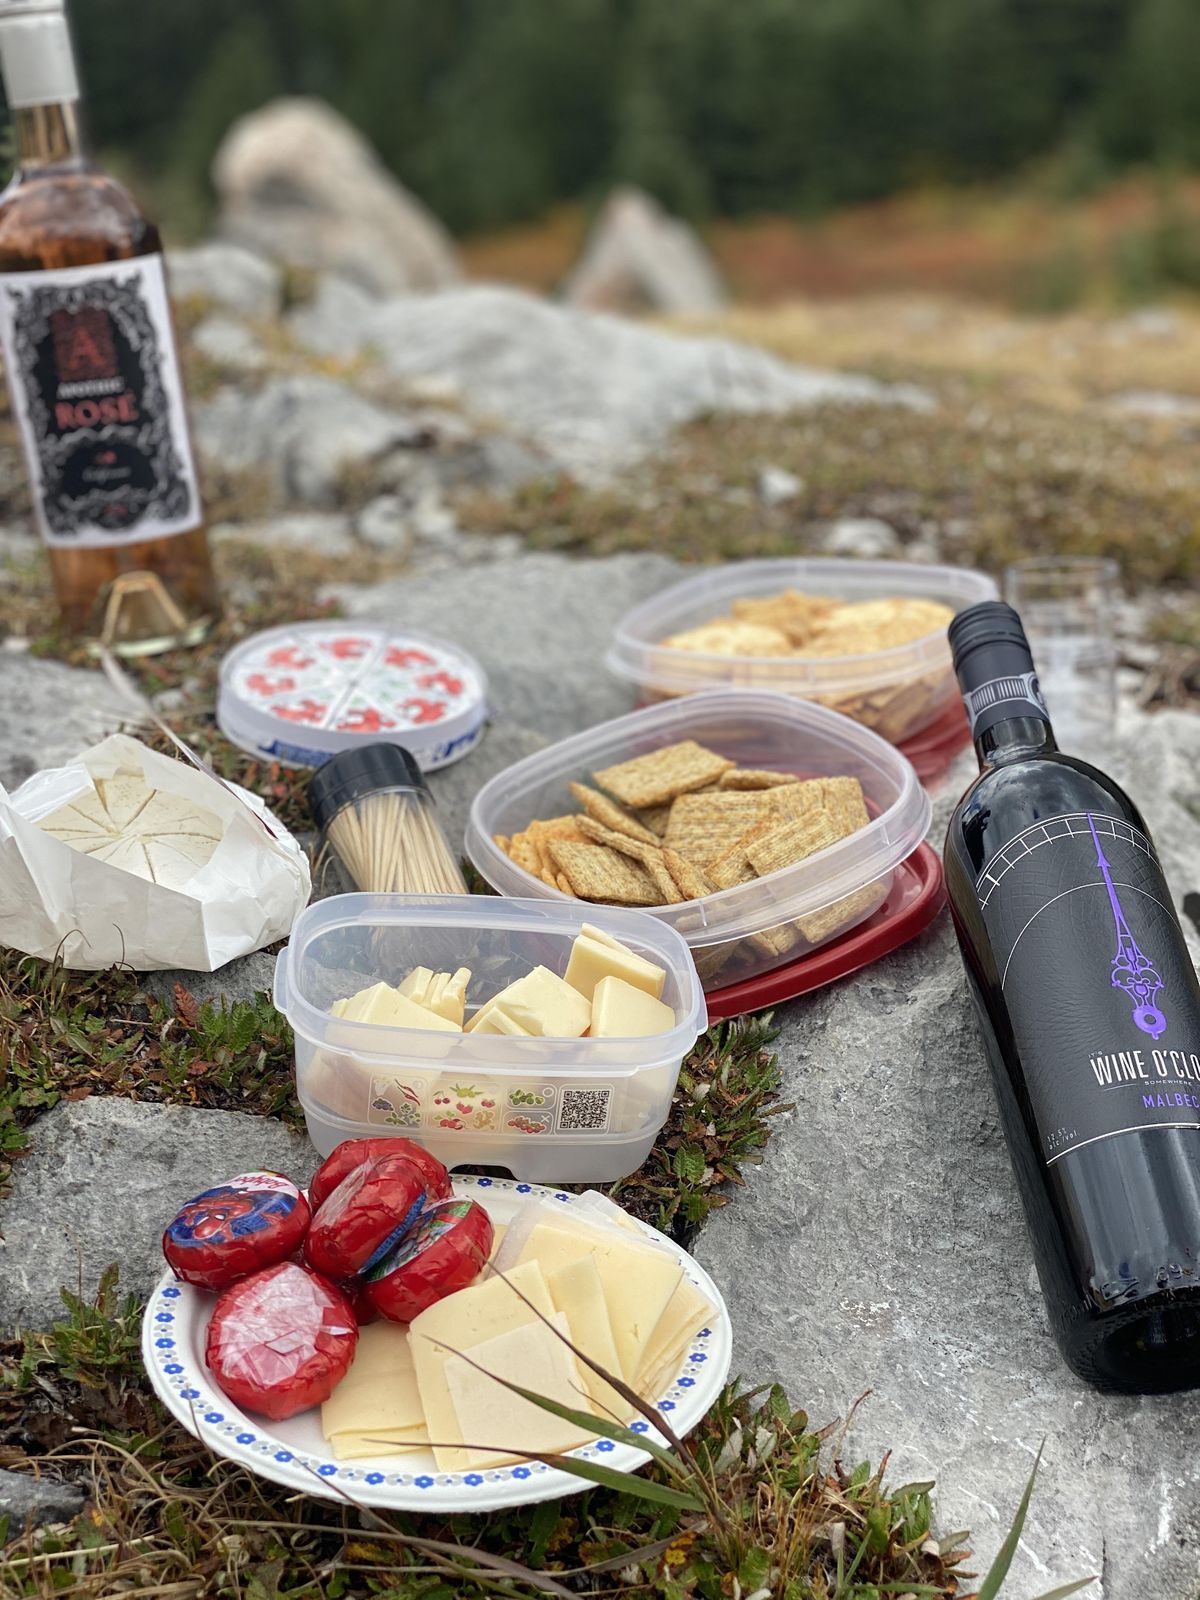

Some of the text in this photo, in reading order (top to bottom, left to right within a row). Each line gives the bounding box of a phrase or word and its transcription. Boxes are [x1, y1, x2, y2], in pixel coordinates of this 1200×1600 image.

[1089, 1050, 1149, 1086] WINE
[1144, 1079, 1193, 1087] SOMEWHERE
[1142, 1093, 1200, 1109] MALBEC
